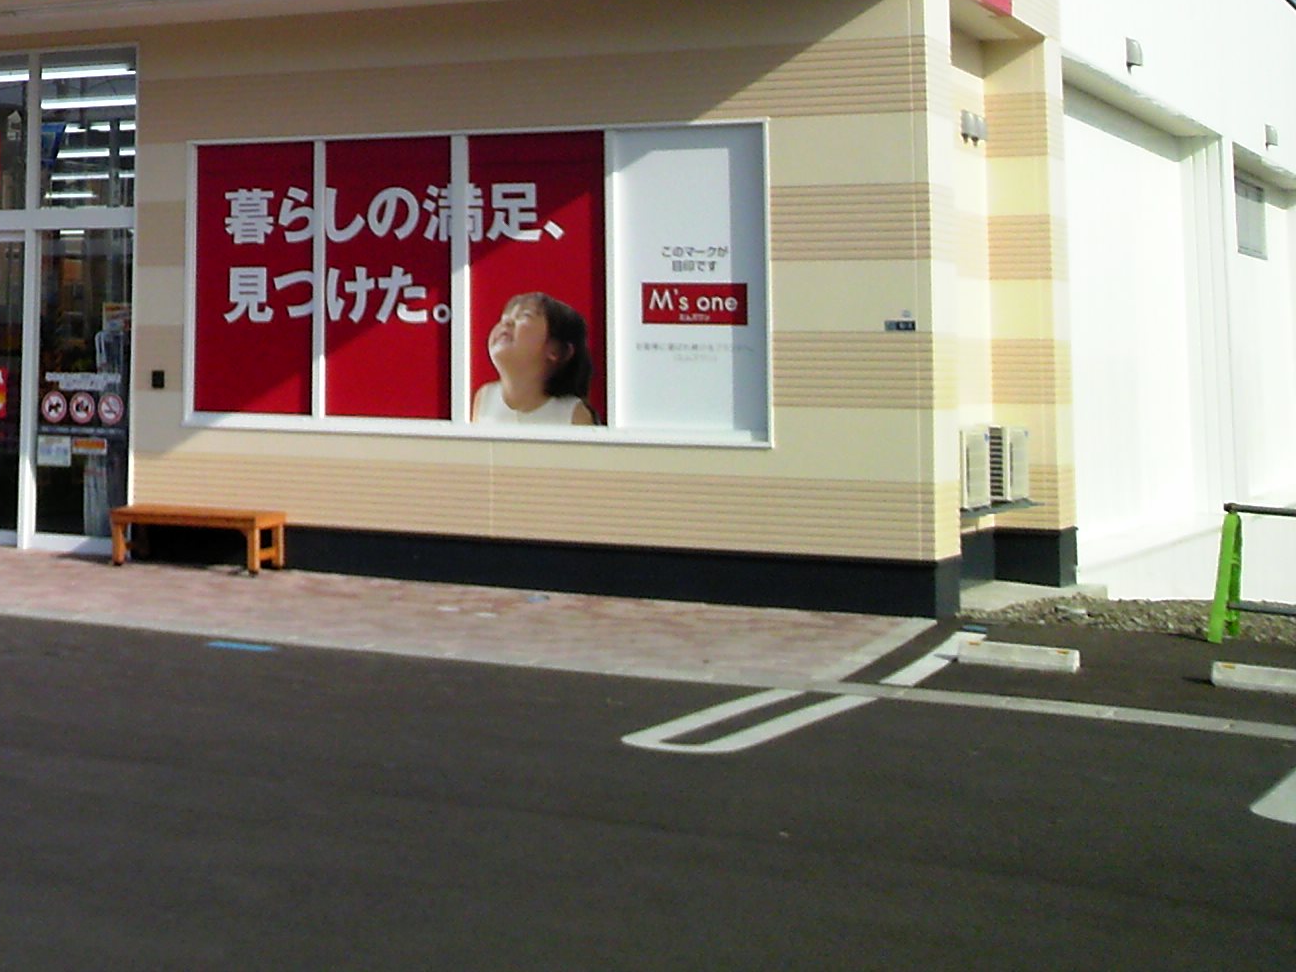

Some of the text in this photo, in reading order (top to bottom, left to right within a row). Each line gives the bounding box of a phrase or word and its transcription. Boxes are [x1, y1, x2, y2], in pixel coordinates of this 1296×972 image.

[224, 182, 565, 245] 暮らしの満足、
[661, 246, 728, 258] このマークが
[224, 266, 452, 324] 見つけた。
[649, 288, 738, 312] M's one
